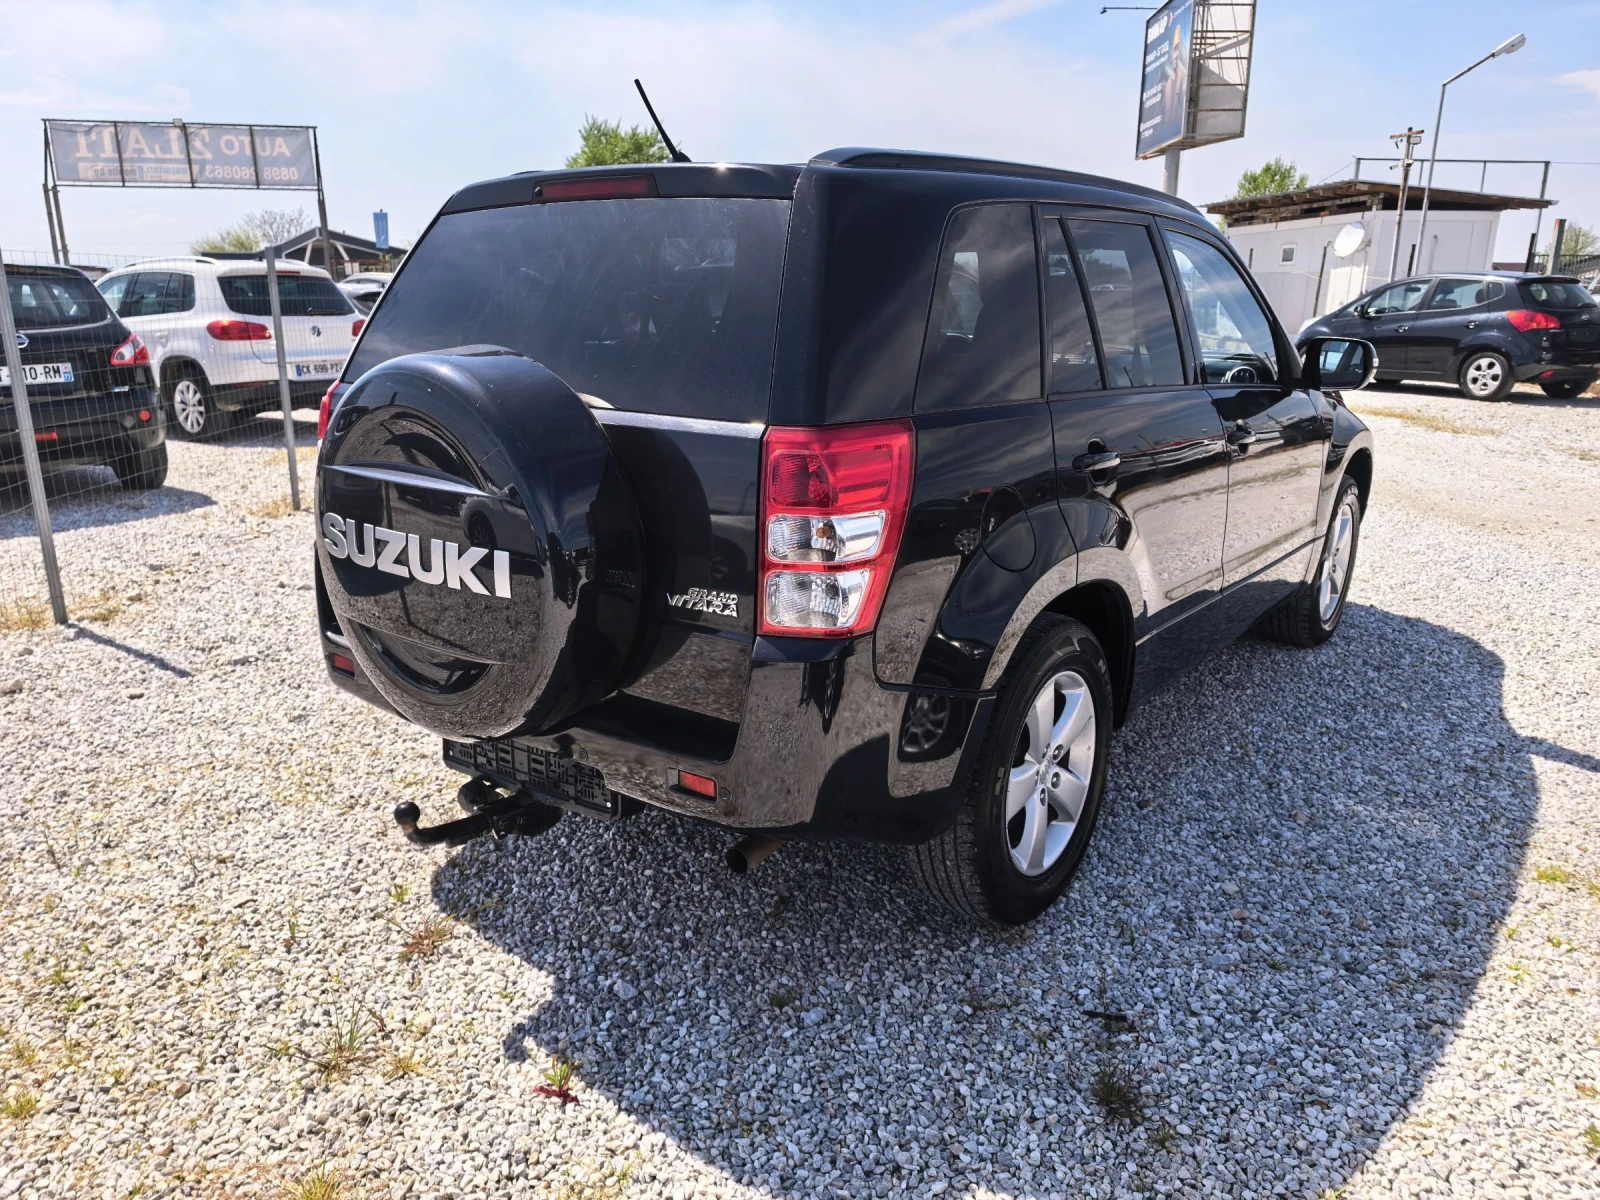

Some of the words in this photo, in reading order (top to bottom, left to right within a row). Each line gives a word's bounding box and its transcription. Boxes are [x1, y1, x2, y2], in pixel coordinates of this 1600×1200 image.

[323, 512, 512, 598] SUZUKI
[666, 592, 738, 618] VITARA
[687, 588, 739, 604] GRAND
